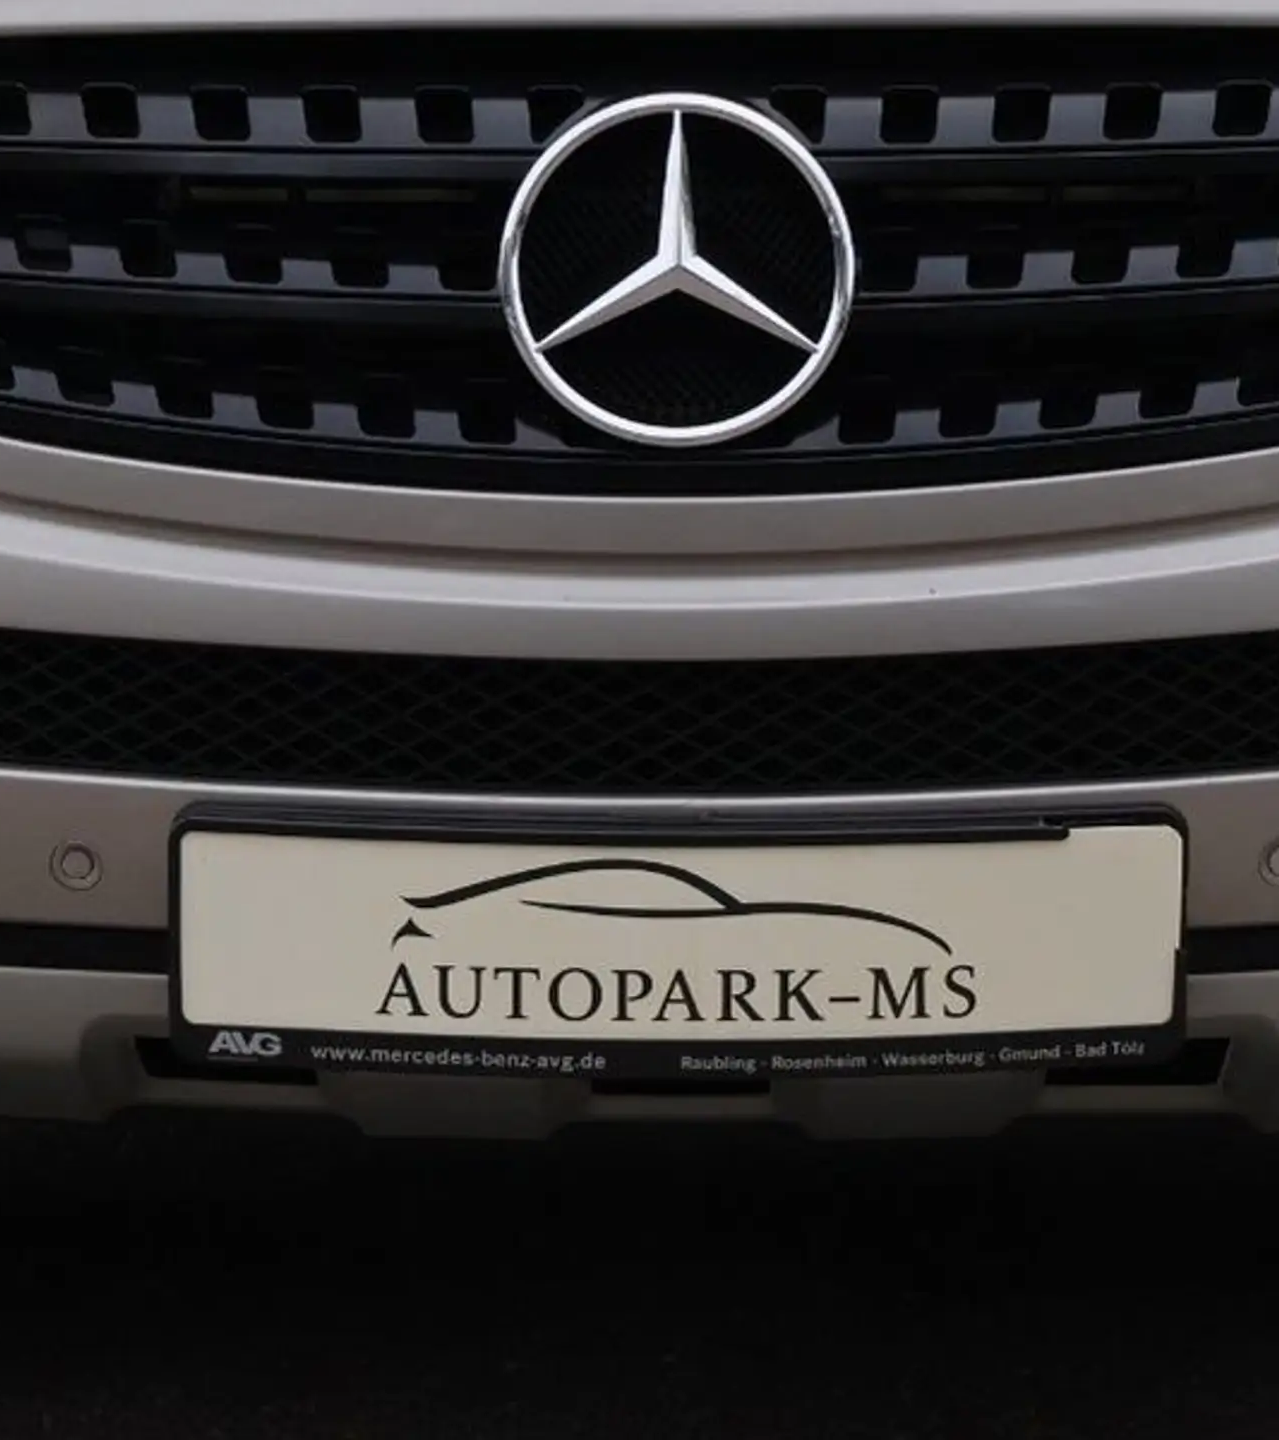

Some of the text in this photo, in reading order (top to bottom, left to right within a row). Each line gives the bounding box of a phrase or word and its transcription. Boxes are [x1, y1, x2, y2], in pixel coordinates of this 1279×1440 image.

[375, 962, 979, 1022] AUTOPARK-MS
[208, 1030, 283, 1057] AVG
[310, 1042, 607, 1073] www.mercedes-benz-avg.de
[680, 1055, 757, 1075] Raubling
[771, 1053, 868, 1070] Rosenheim
[881, 1049, 986, 1068] Wasserburg
[1075, 1041, 1107, 1059] Bad
